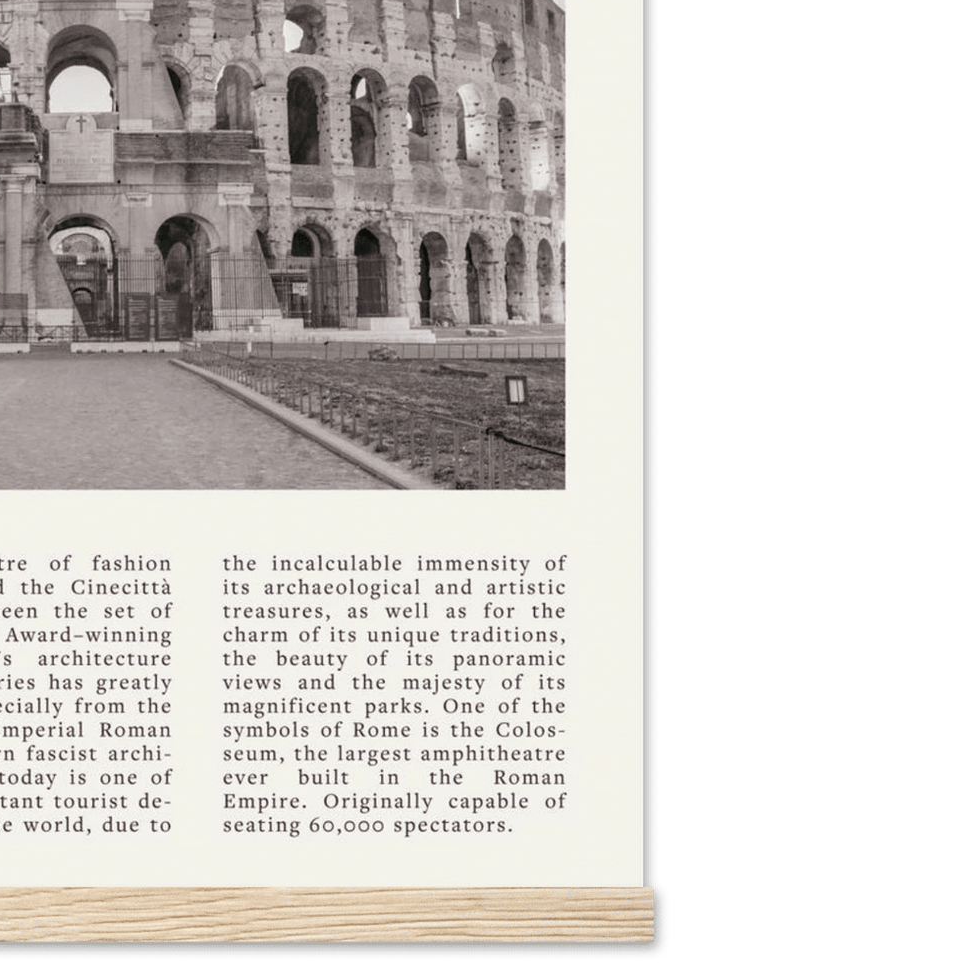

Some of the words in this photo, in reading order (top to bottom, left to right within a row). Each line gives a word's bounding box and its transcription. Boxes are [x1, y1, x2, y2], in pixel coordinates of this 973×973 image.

[93, 555, 170, 571] fashion
[223, 555, 256, 571] the
[273, 555, 401, 571] incalculable
[418, 555, 530, 576] immensity
[21, 579, 54, 595] the
[71, 578, 171, 595] Cinecittà
[224, 579, 249, 595] its
[265, 579, 419, 600] archaeological
[435, 579, 472, 594] and
[487, 579, 565, 595] artistic
[55, 603, 87, 618] the
[104, 606, 134, 618] set
[223, 606, 330, 621] treasures,
[385, 602, 428, 618] well
[484, 602, 515, 618] for
[532, 603, 565, 618] the
[223, 626, 287, 642] charm
[331, 627, 356, 642] its
[368, 627, 439, 647] unique
[451, 626, 565, 645] traditions,
[39, 650, 171, 666] architecture
[223, 650, 256, 666] the
[276, 650, 347, 671] beauty
[407, 650, 433, 666] its
[453, 650, 565, 671] panoramic
[49, 674, 82, 690] has
[96, 674, 171, 695] greatly
[223, 674, 281, 690] views
[299, 674, 335, 690] and
[403, 674, 485, 695] majesty
[540, 674, 565, 690] its
[75, 697, 124, 713] from
[138, 698, 170, 713] the
[224, 697, 351, 719] magnificent
[365, 698, 428, 718] parks.
[443, 699, 484, 713] One
[532, 698, 565, 713] the
[100, 722, 170, 737] Roman
[224, 721, 309, 742] symbols
[354, 722, 410, 737] Rome
[451, 721, 483, 737] the
[496, 721, 564, 737] Colos-
[27, 745, 96, 761] fascist
[109, 745, 170, 761] archi-
[224, 750, 284, 763] seum,
[295, 745, 327, 761] the
[338, 745, 410, 766] largest
[421, 745, 565, 766] amphitheatre
[100, 774, 137, 785] one
[223, 774, 268, 785] ever
[299, 769, 348, 785] built
[430, 769, 462, 785] the
[494, 770, 565, 785] Roman
[54, 793, 127, 809] tourist
[139, 792, 170, 808] de-
[224, 793, 306, 813] Empire.
[324, 793, 432, 814] Originally
[449, 793, 528, 813] capable
[24, 816, 91, 835] world,
[103, 816, 139, 832] due
[224, 817, 300, 837] seating
[310, 817, 384, 835] 60,000
[394, 820, 512, 837] spectators.
